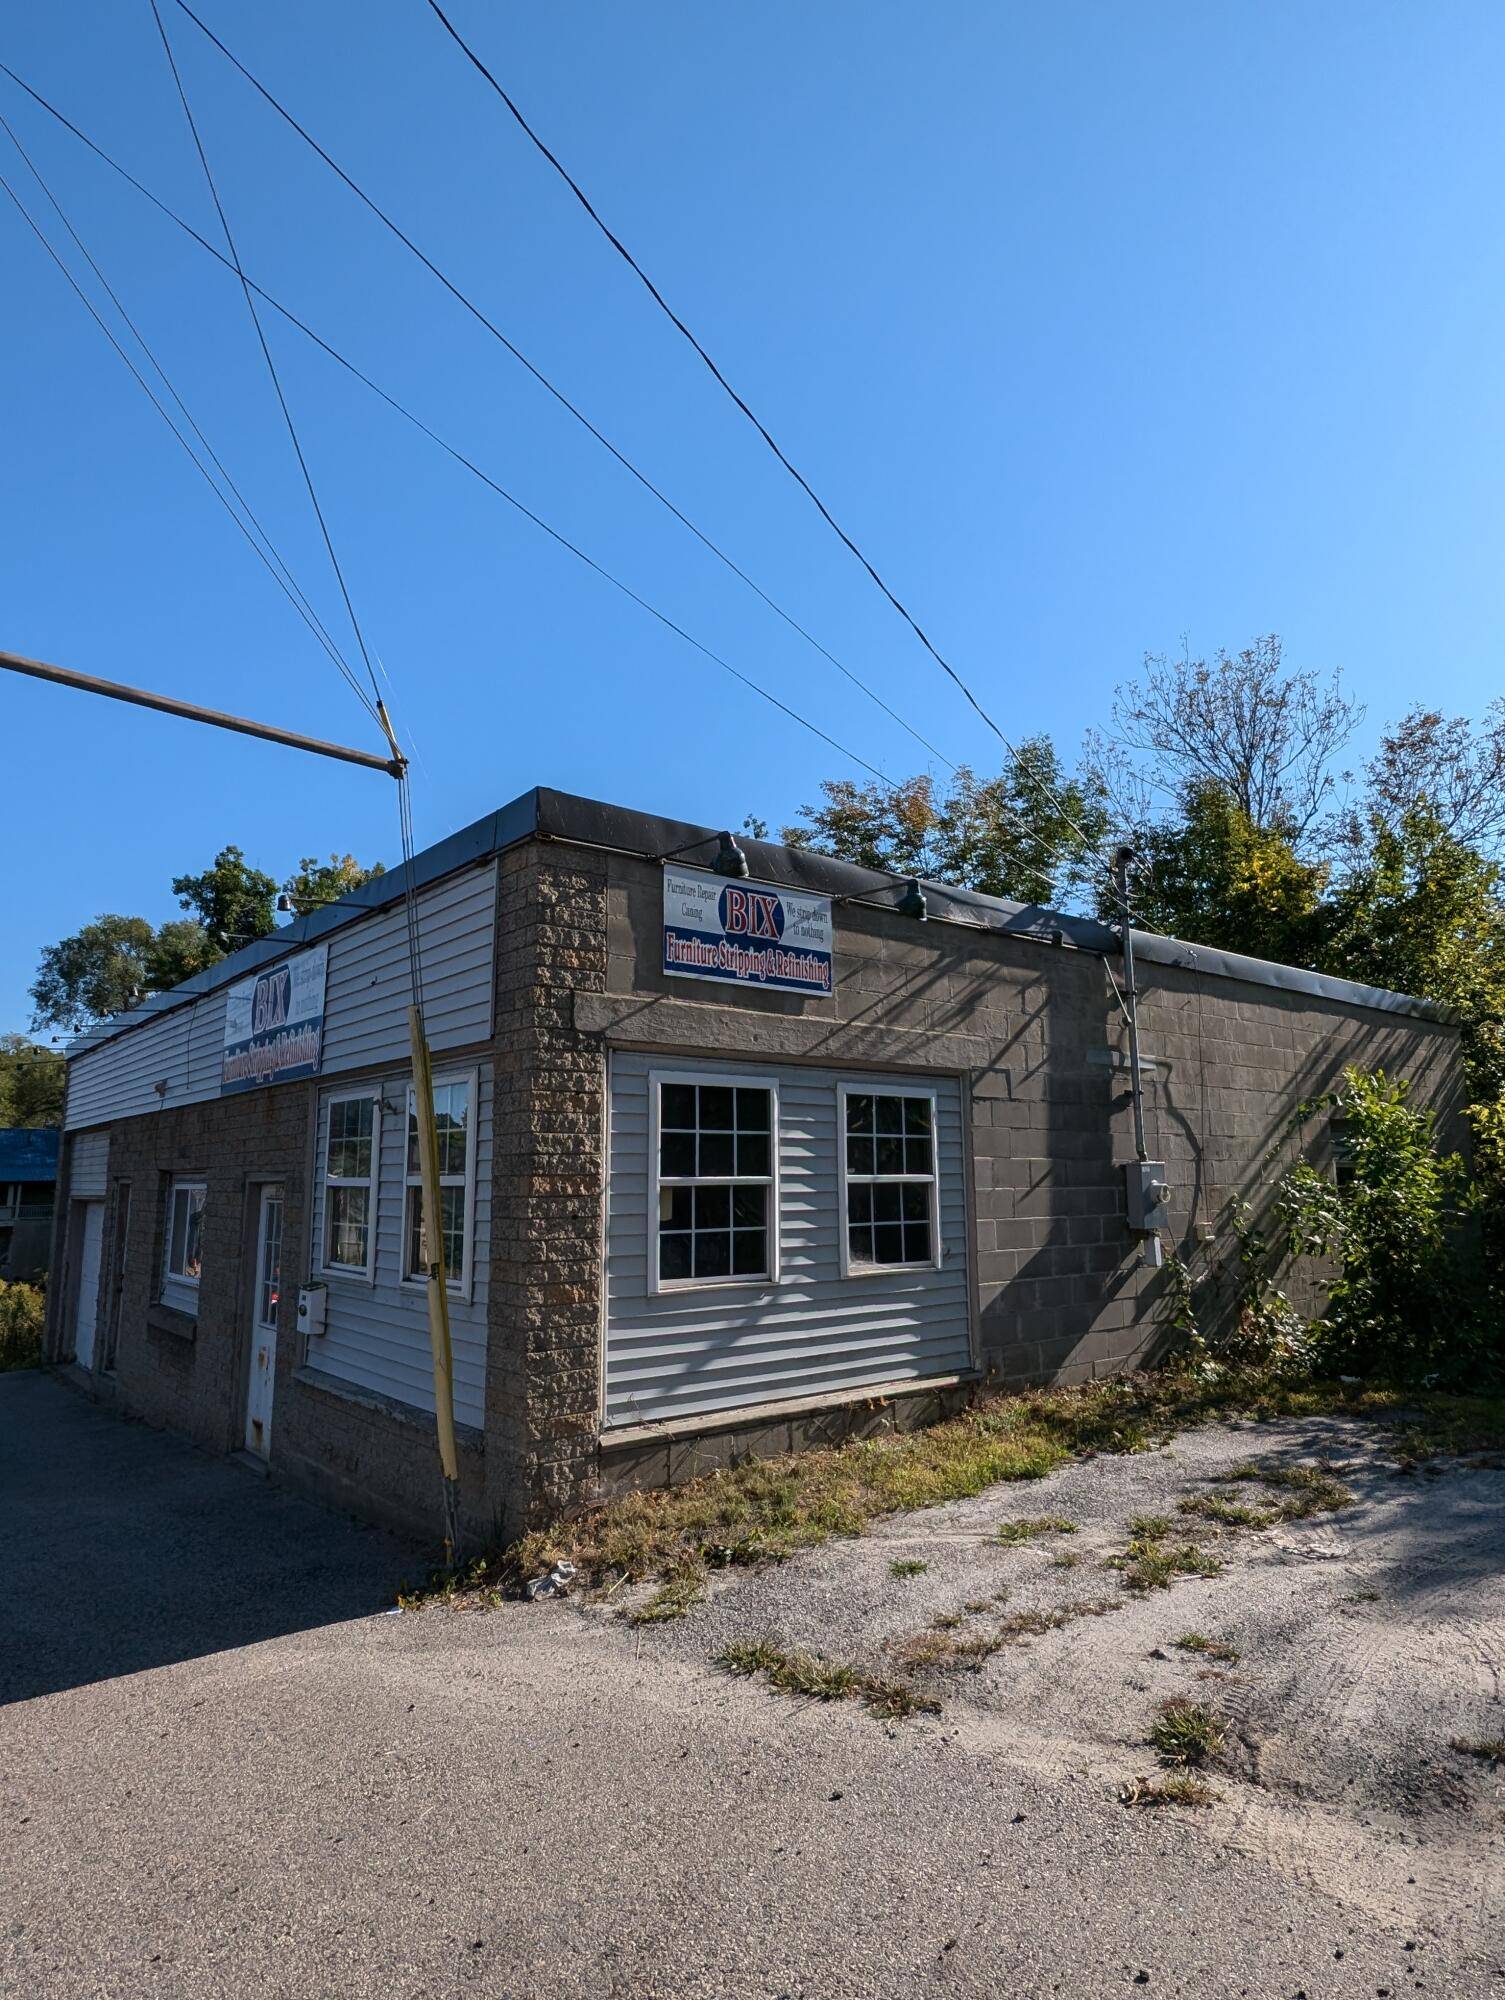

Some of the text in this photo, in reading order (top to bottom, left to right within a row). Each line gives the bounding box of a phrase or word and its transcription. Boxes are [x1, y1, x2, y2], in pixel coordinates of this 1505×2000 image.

[667, 879, 716, 902] Furniture Repair
[726, 888, 780, 939] BIX
[786, 902, 796, 917] We
[666, 932, 829, 989] Furniture Stripping & Refinishing
[254, 969, 289, 1034] BIX
